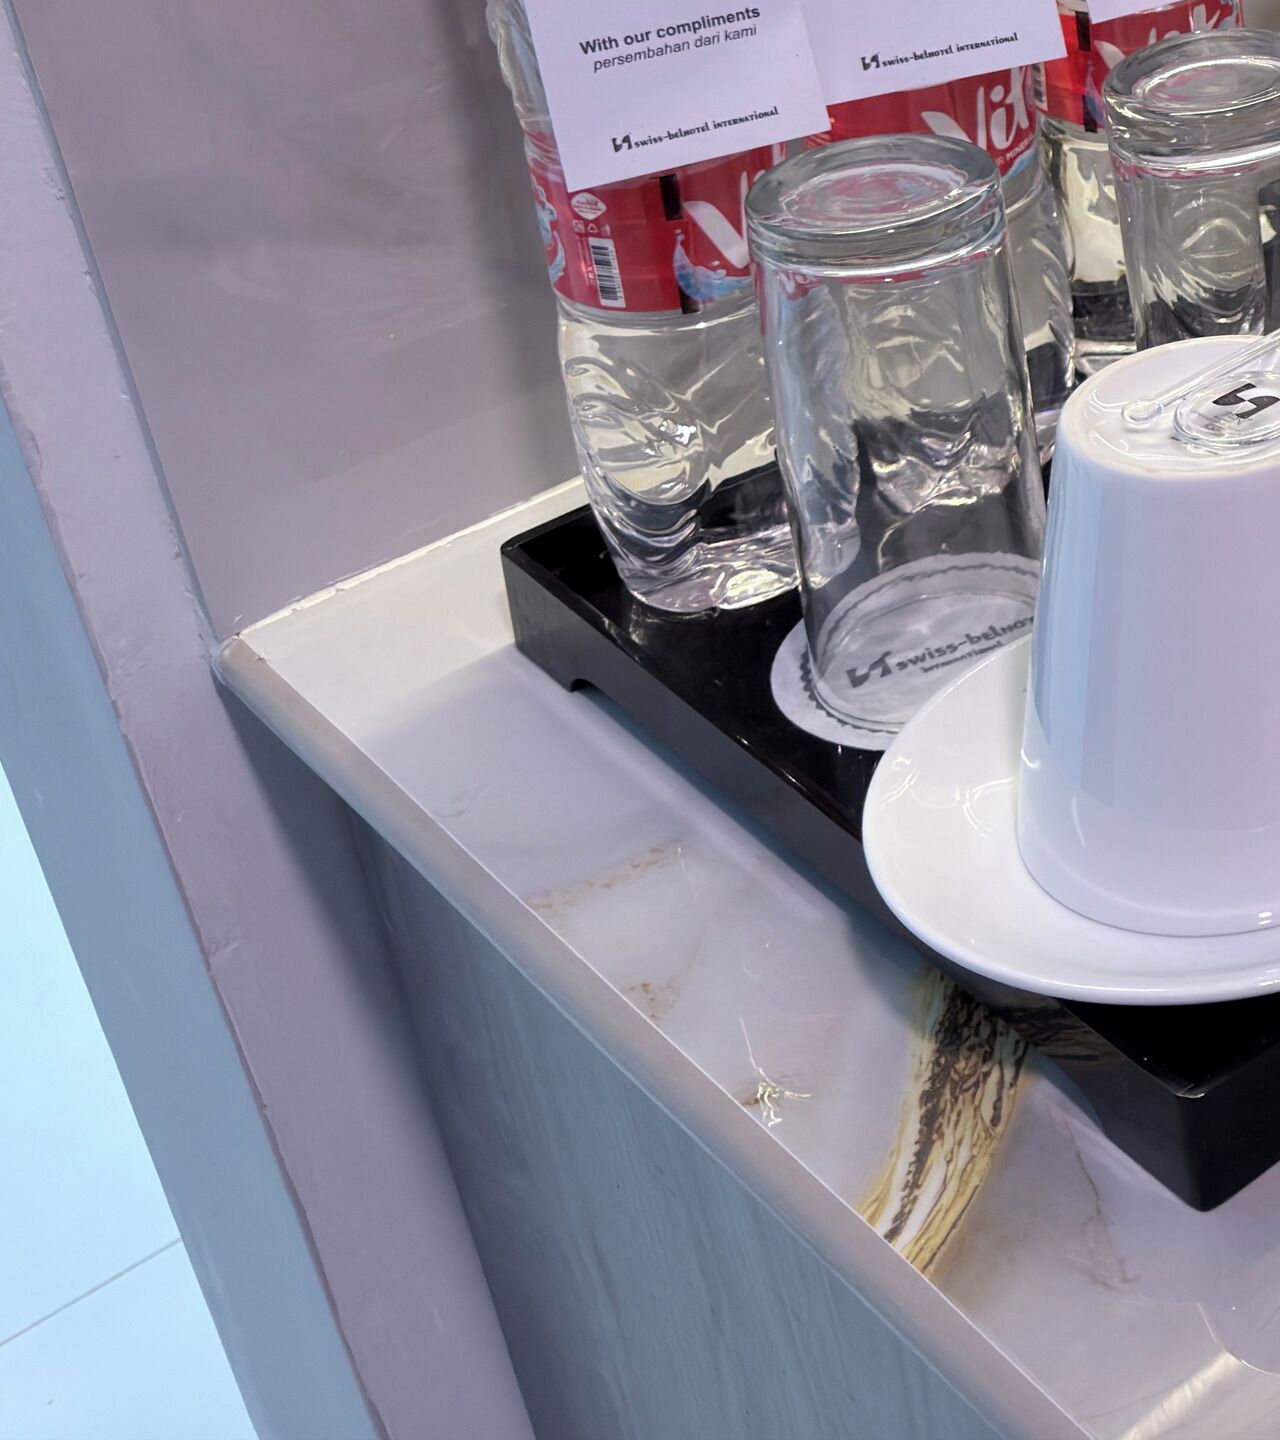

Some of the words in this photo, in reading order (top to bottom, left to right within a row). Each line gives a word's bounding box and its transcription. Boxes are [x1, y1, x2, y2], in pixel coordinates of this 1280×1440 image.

[579, 33, 619, 56] With
[624, 30, 651, 46] our
[656, 7, 761, 38] compliments
[593, 39, 690, 73] persembahan
[694, 30, 720, 48] dari
[724, 24, 758, 42] kami
